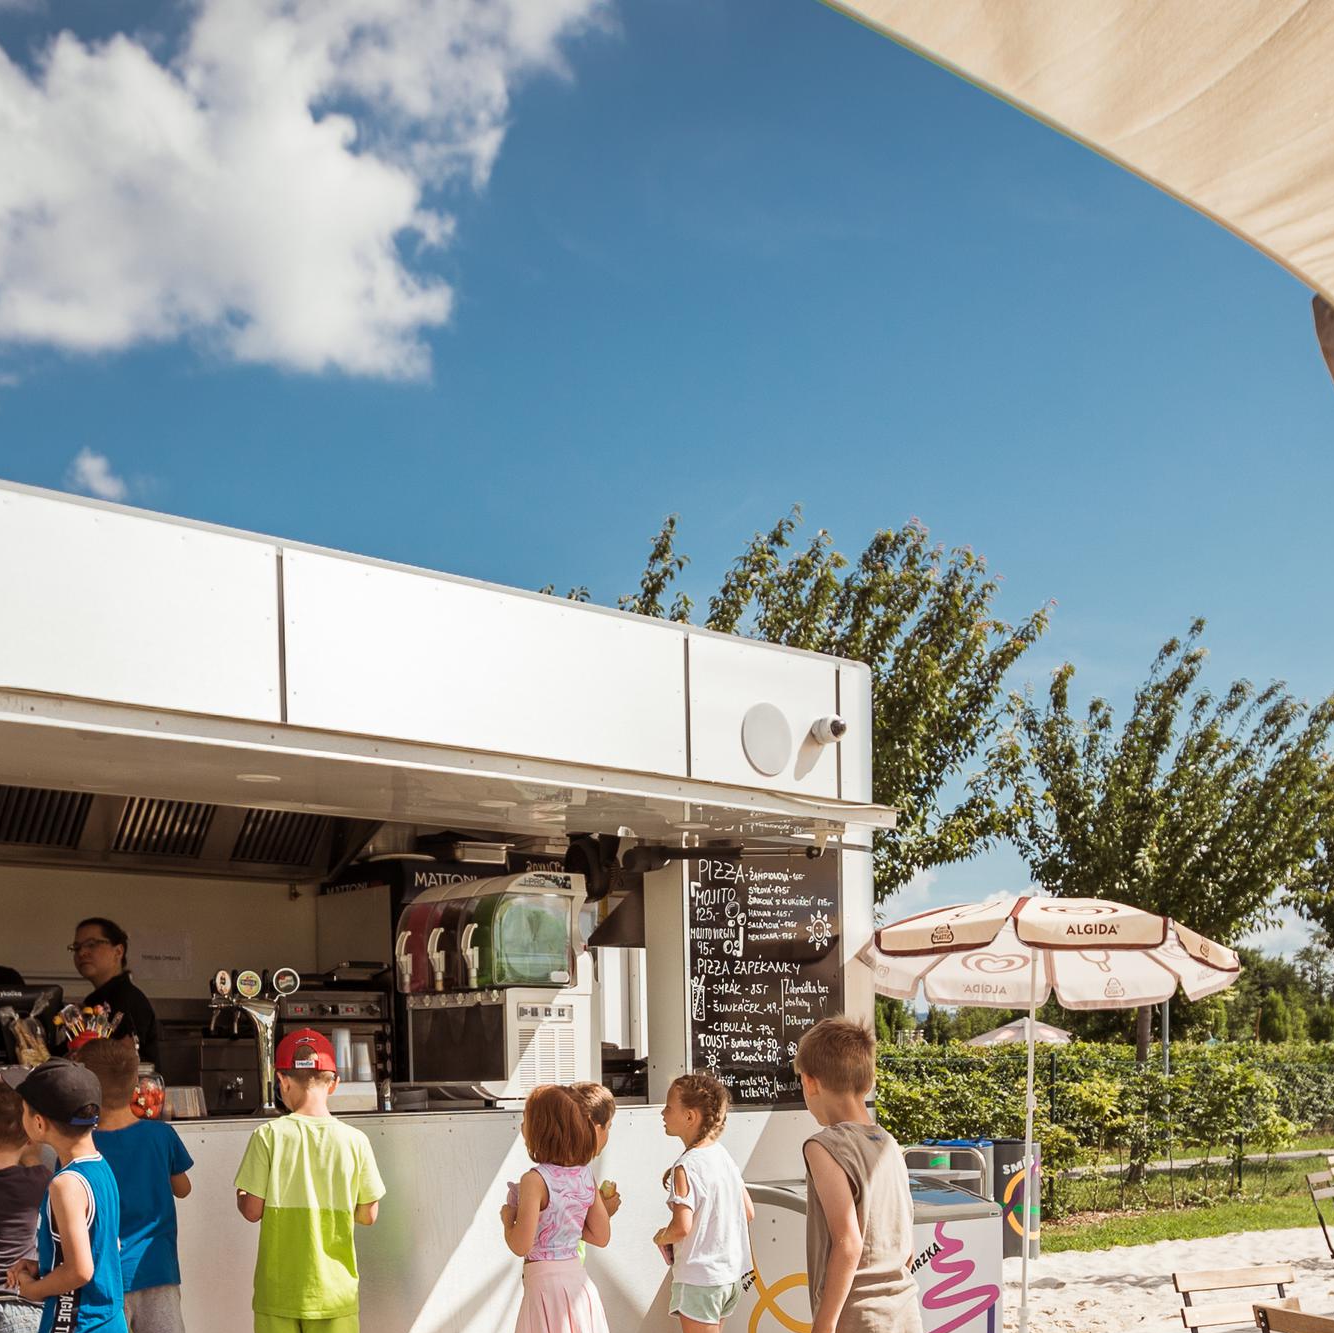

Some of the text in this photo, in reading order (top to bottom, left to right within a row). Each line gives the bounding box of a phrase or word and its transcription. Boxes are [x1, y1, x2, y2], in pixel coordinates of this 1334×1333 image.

[698, 859, 745, 884] PIZZA
[695, 887, 737, 907] MOJITO
[697, 958, 730, 976] PIZZA
[698, 1034, 729, 1049] TOUST
